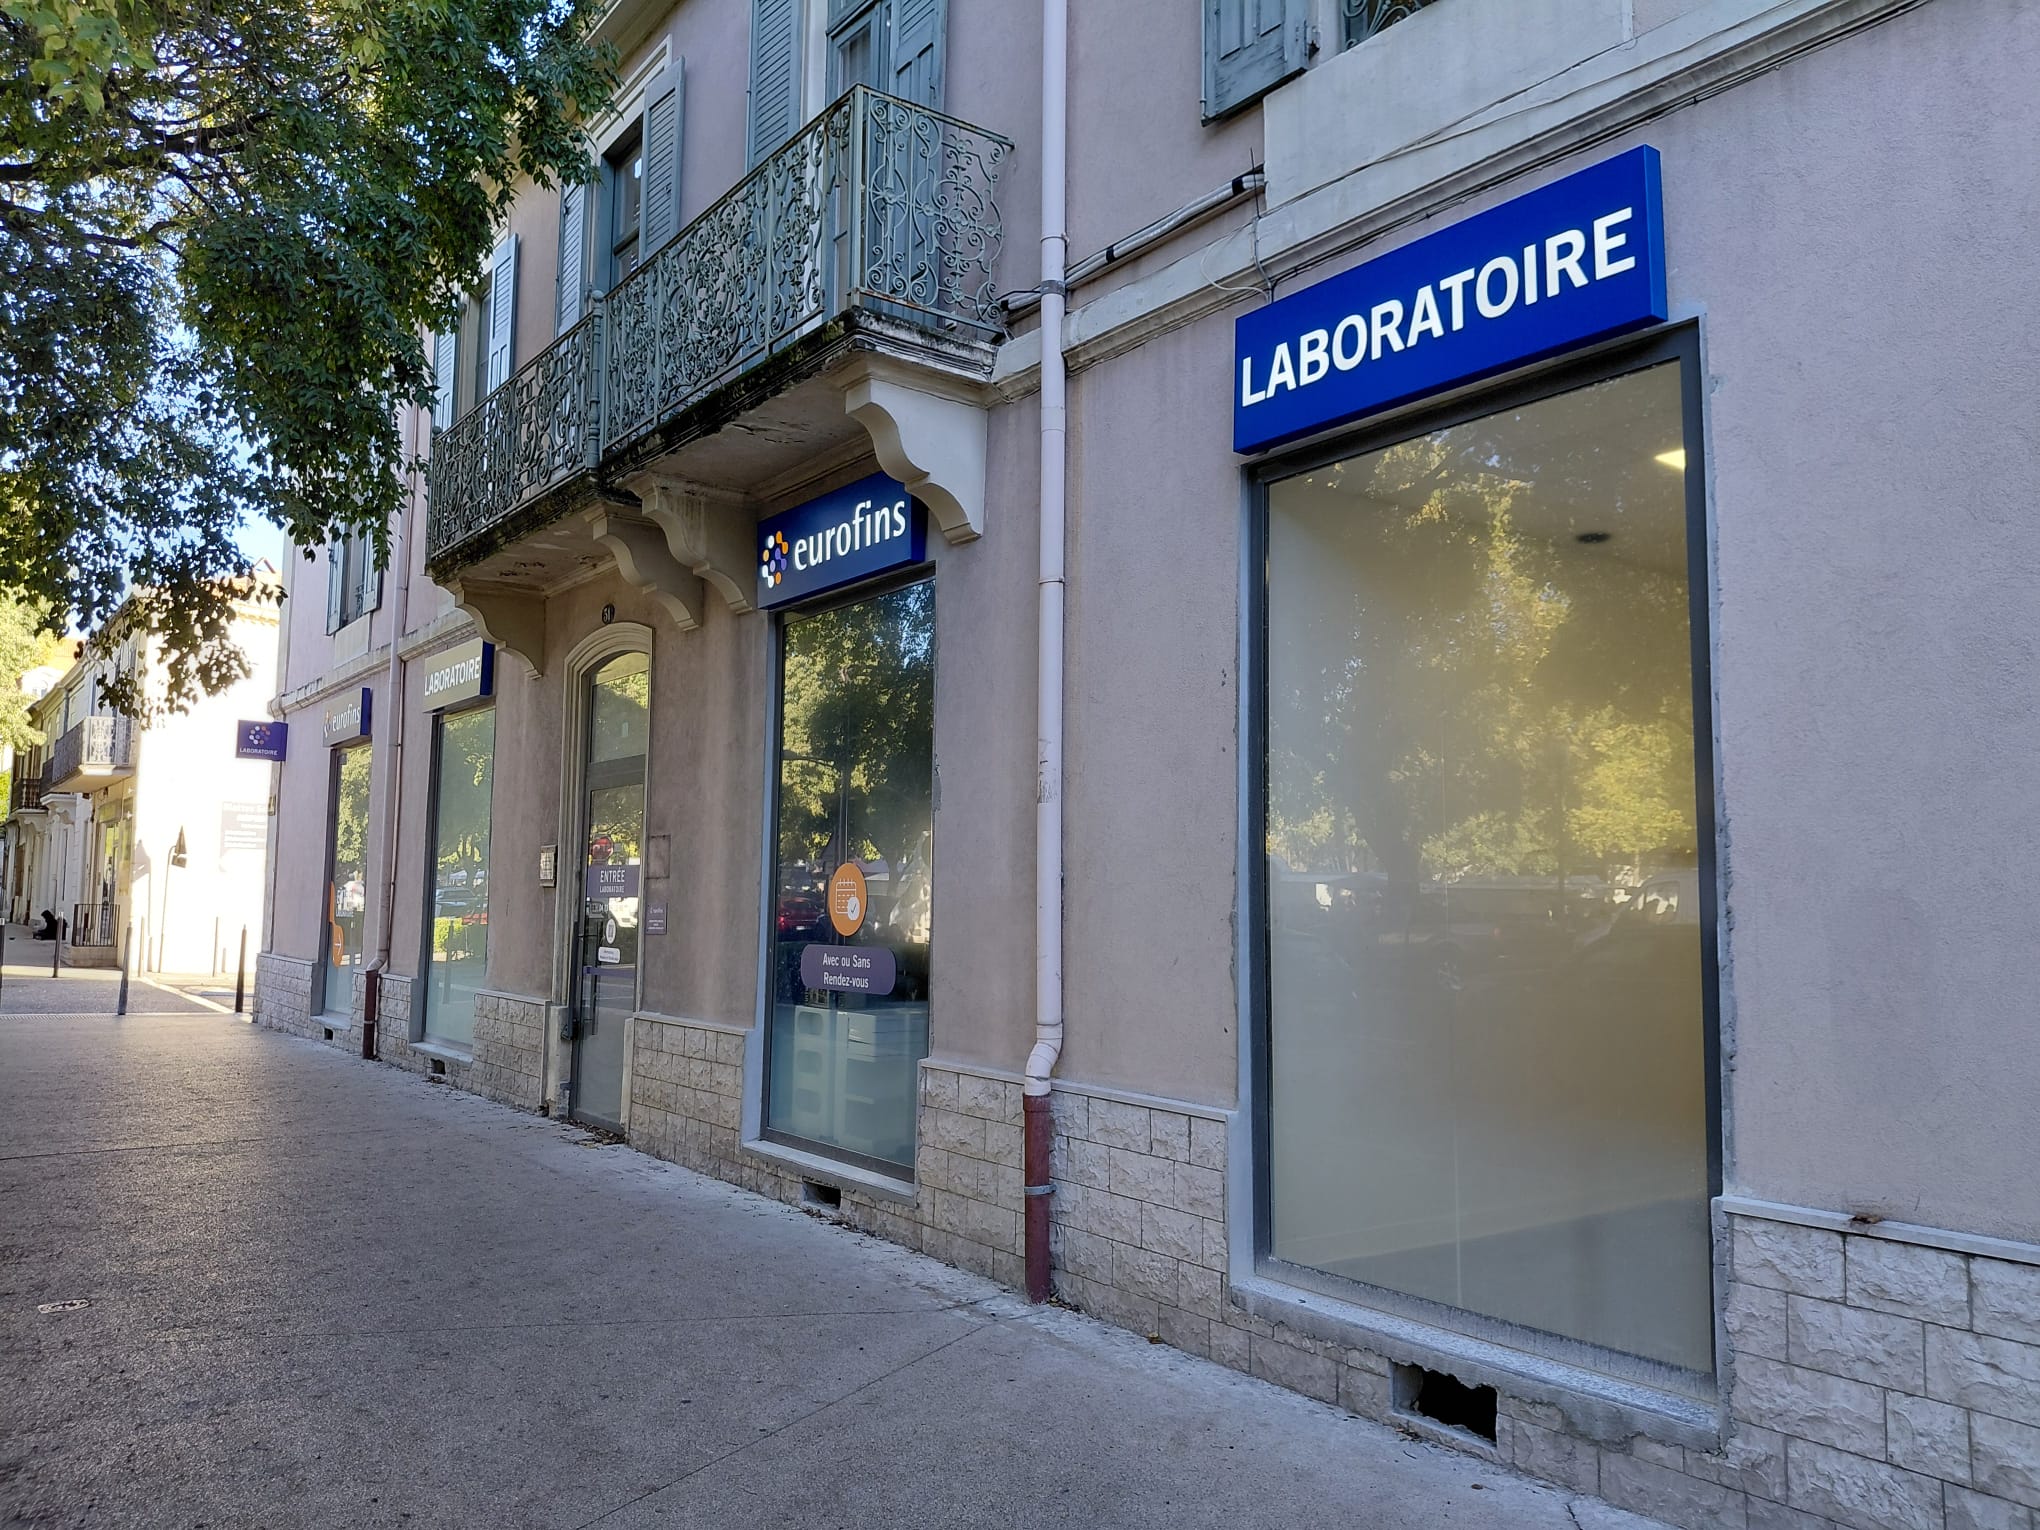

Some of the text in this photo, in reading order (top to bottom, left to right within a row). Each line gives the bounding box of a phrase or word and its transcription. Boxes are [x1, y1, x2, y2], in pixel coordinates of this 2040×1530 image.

[1240, 206, 1636, 408] LABORATOIRE
[793, 499, 906, 571] eurofins
[424, 654, 481, 697] LABORATOIRE
[332, 703, 361, 732] eurofins
[239, 747, 278, 756] LABORATOIRE
[600, 866, 626, 883] ENTRÉE
[823, 953, 871, 969] Avec ou Sans
[824, 972, 869, 988] Rendez-vous
